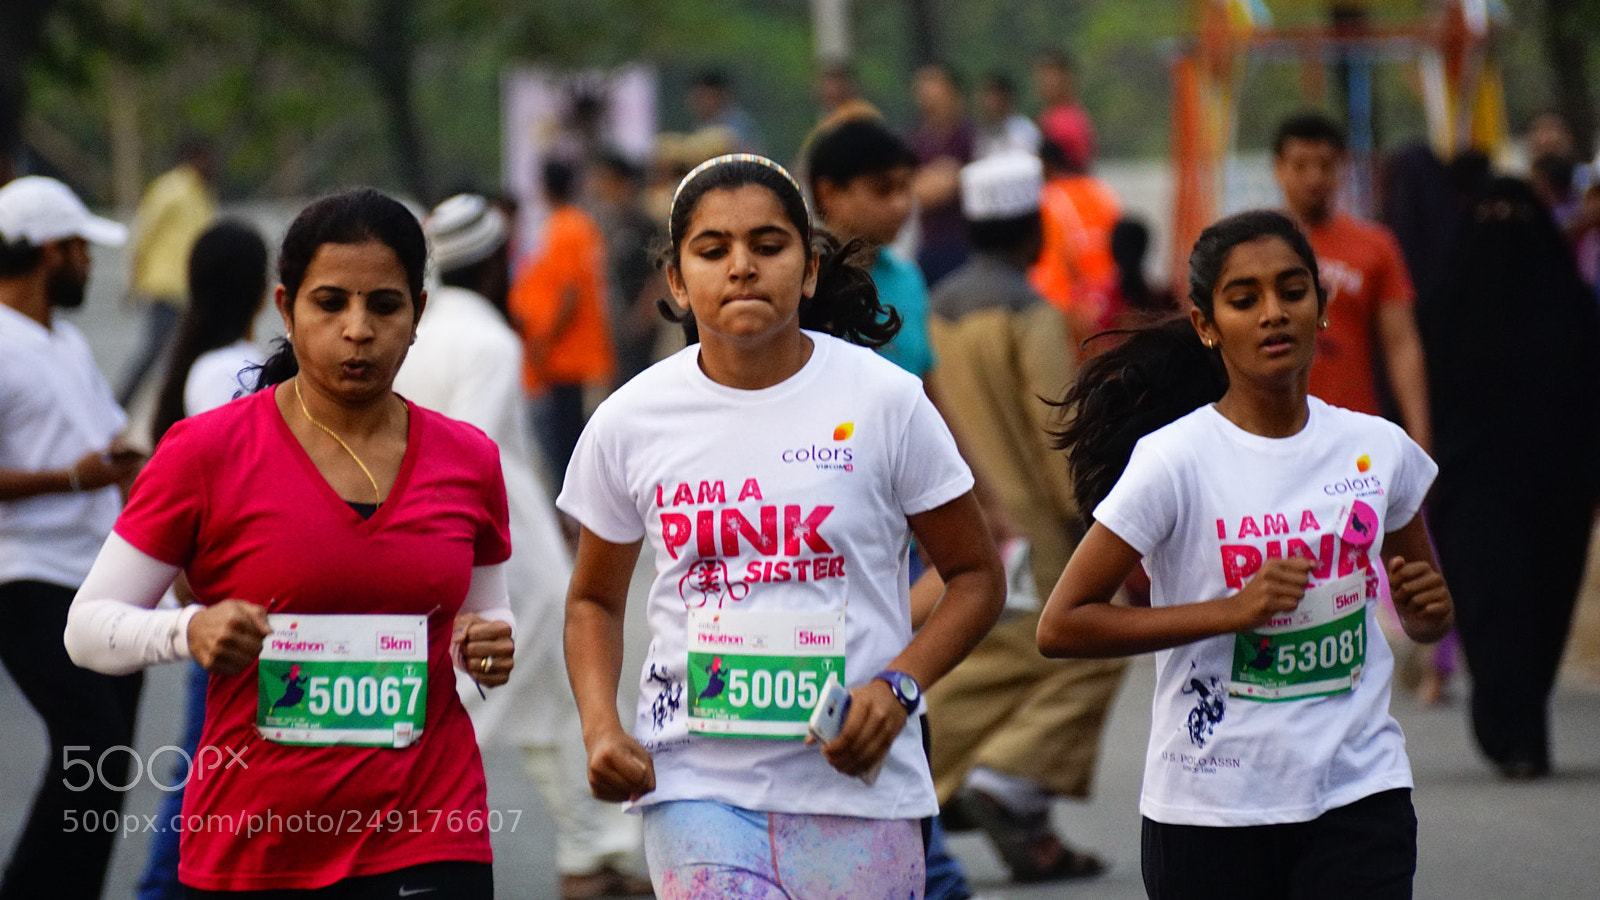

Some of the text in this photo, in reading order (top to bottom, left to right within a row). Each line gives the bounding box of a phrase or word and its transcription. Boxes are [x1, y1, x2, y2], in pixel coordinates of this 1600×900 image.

[782, 444, 853, 463] colors
[656, 478, 763, 507] I AM A
[1323, 475, 1381, 496] colors
[660, 505, 835, 560] PINK
[1216, 519, 1226, 539] I
[1238, 513, 1289, 539] AM
[1300, 510, 1321, 532] A
[744, 556, 845, 583] SISTER
[1336, 591, 1359, 609] 5km
[271, 640, 324, 651] Pinkathon
[380, 636, 412, 650] 5km
[799, 631, 831, 645] 5km
[1276, 622, 1364, 675] 53081
[308, 676, 423, 716] 50067
[728, 669, 838, 709] 5005
[1180, 753, 1207, 767] POLO
